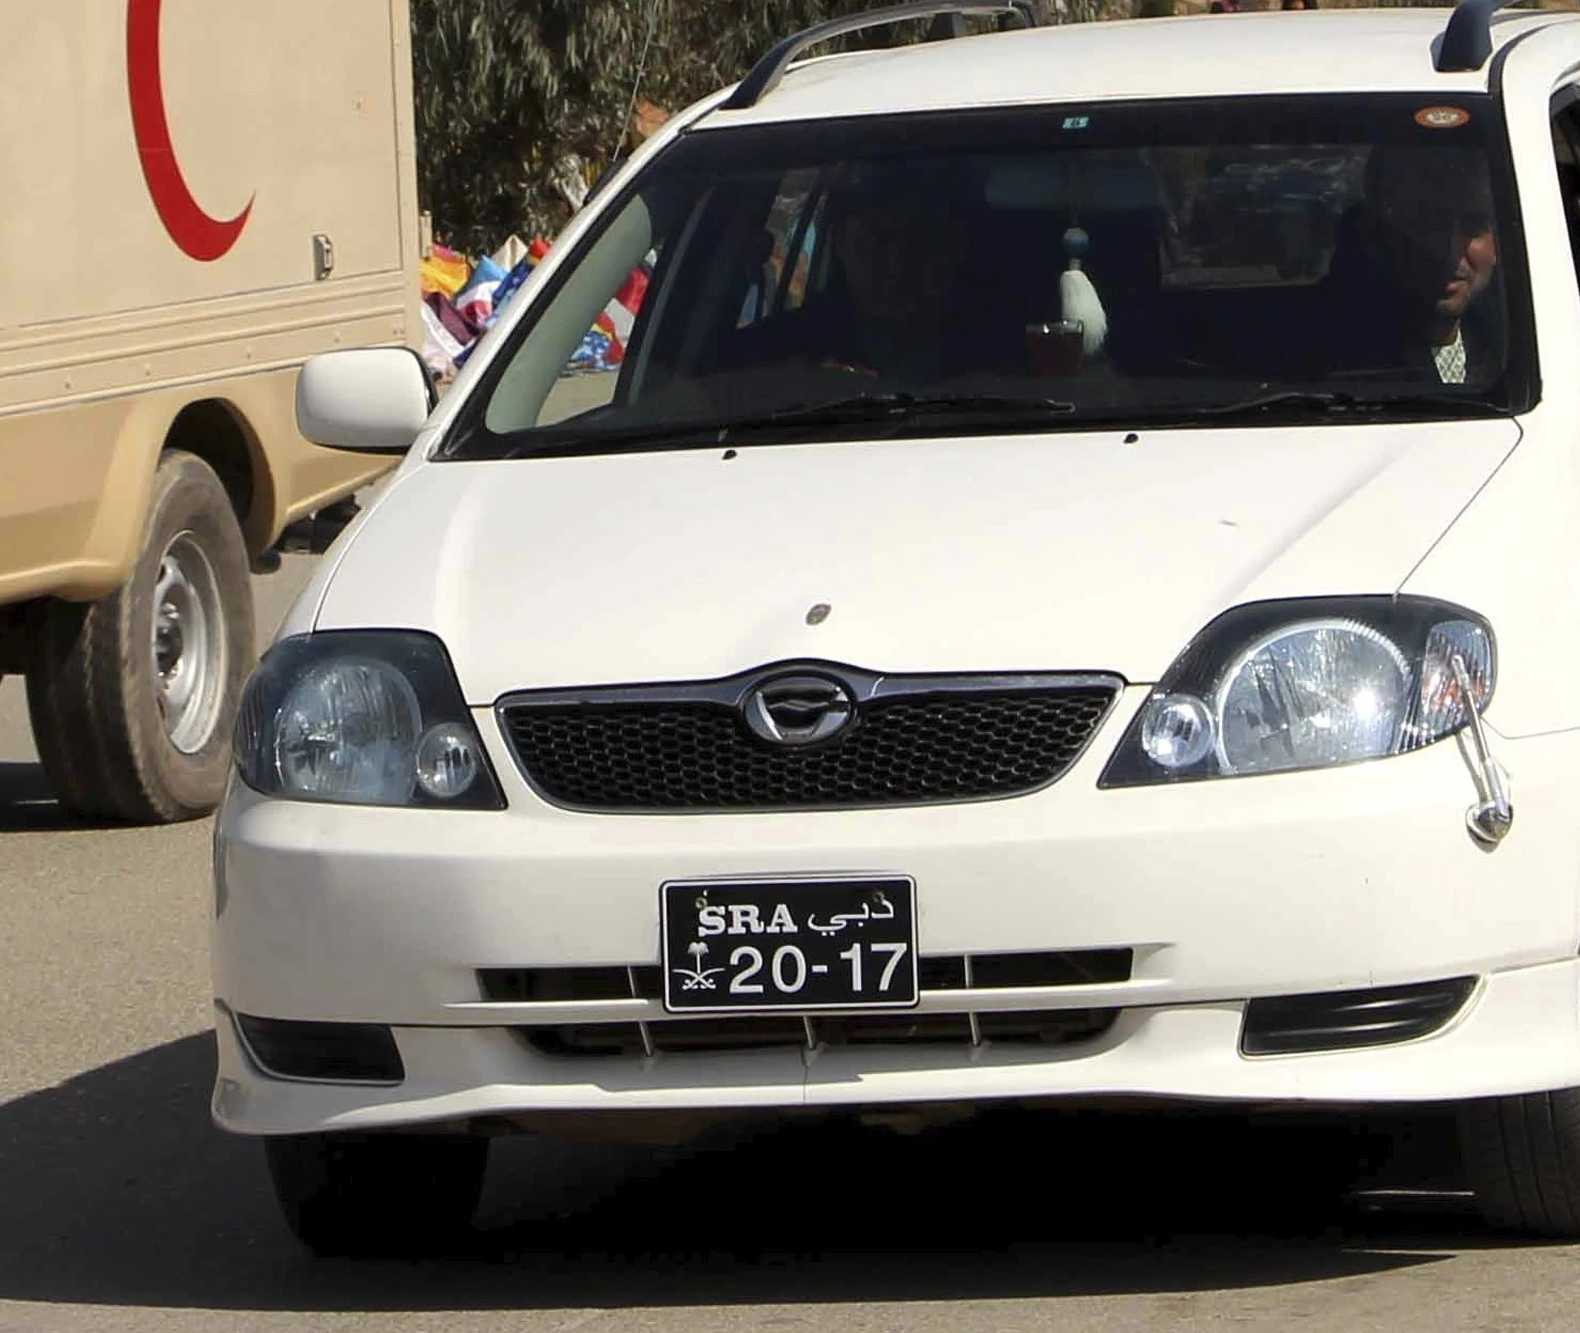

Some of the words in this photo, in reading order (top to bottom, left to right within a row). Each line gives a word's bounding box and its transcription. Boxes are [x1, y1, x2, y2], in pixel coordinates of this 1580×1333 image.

[698, 904, 797, 937] SRA
[807, 900, 894, 936] دبي
[729, 942, 908, 994] 20-17
